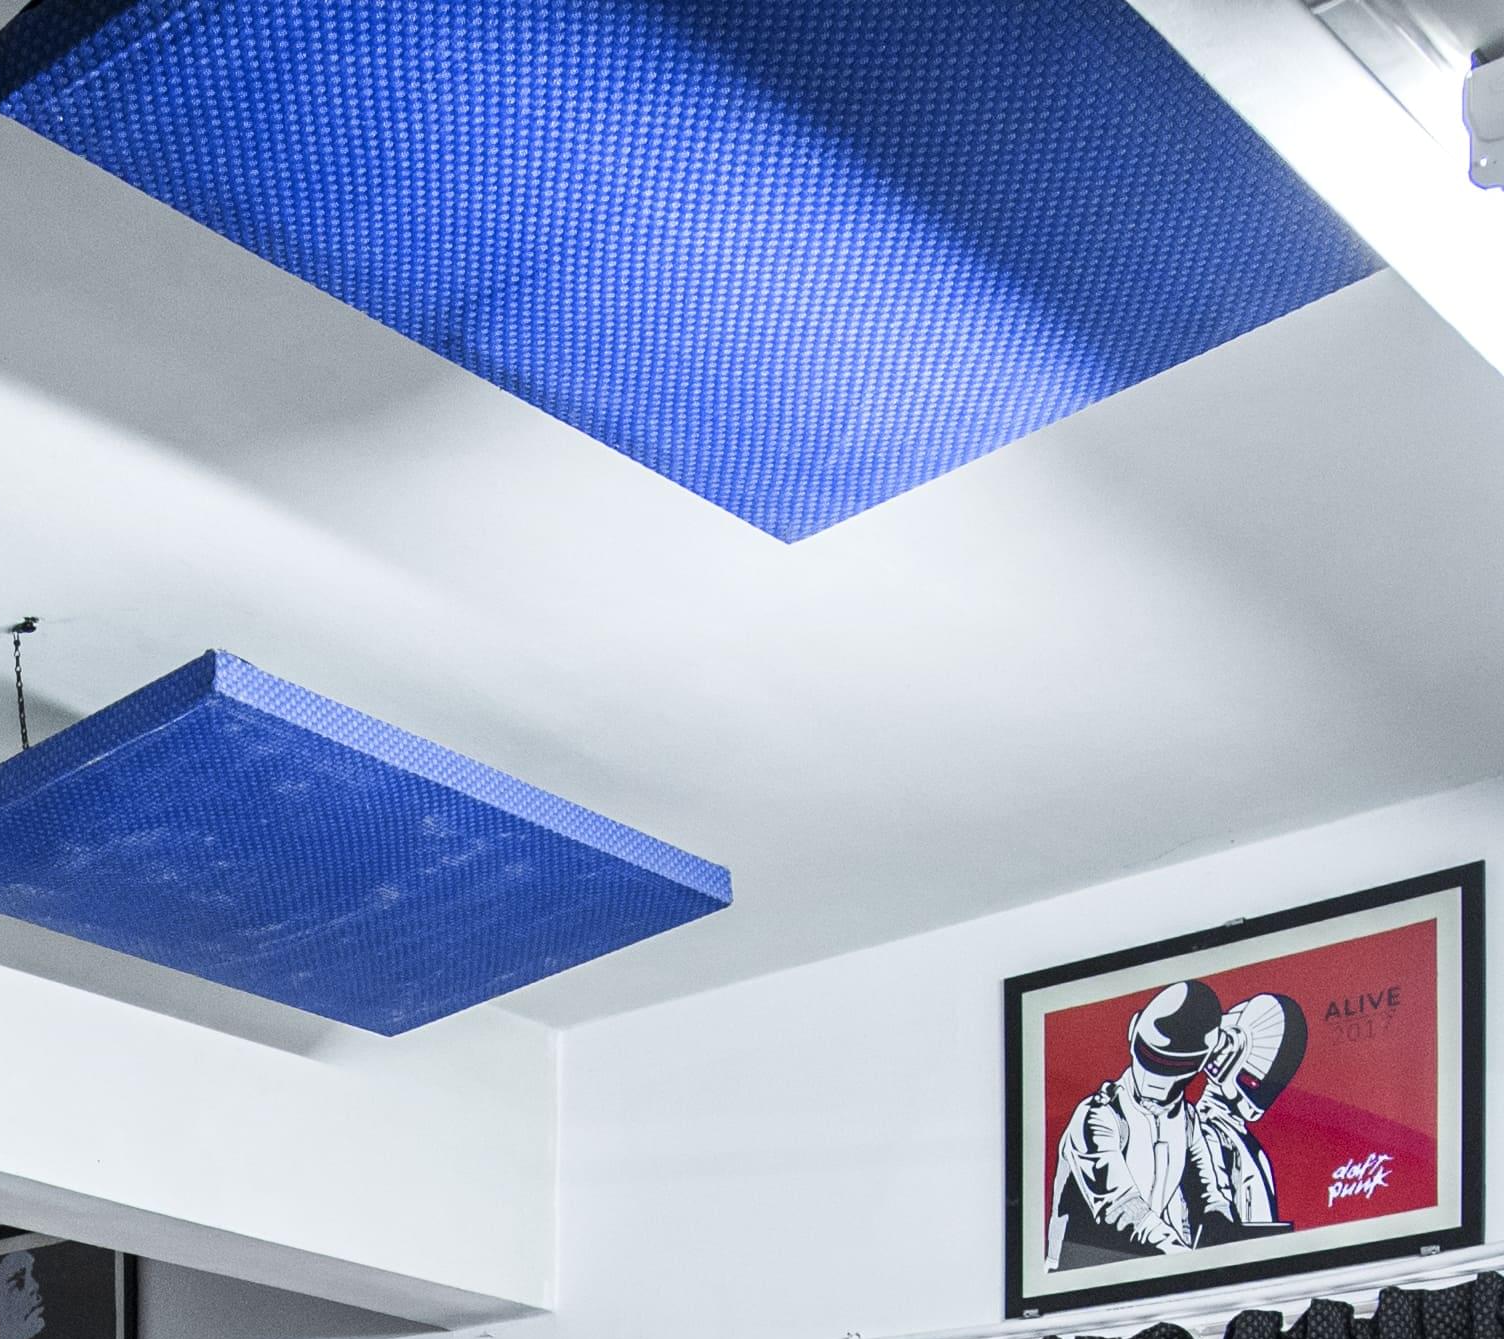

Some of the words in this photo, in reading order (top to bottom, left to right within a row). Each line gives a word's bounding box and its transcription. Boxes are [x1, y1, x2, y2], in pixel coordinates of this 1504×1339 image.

[1325, 986, 1401, 1021] ALIVE
[1331, 1152, 1394, 1180] daft
[1328, 1165, 1392, 1208] punk
